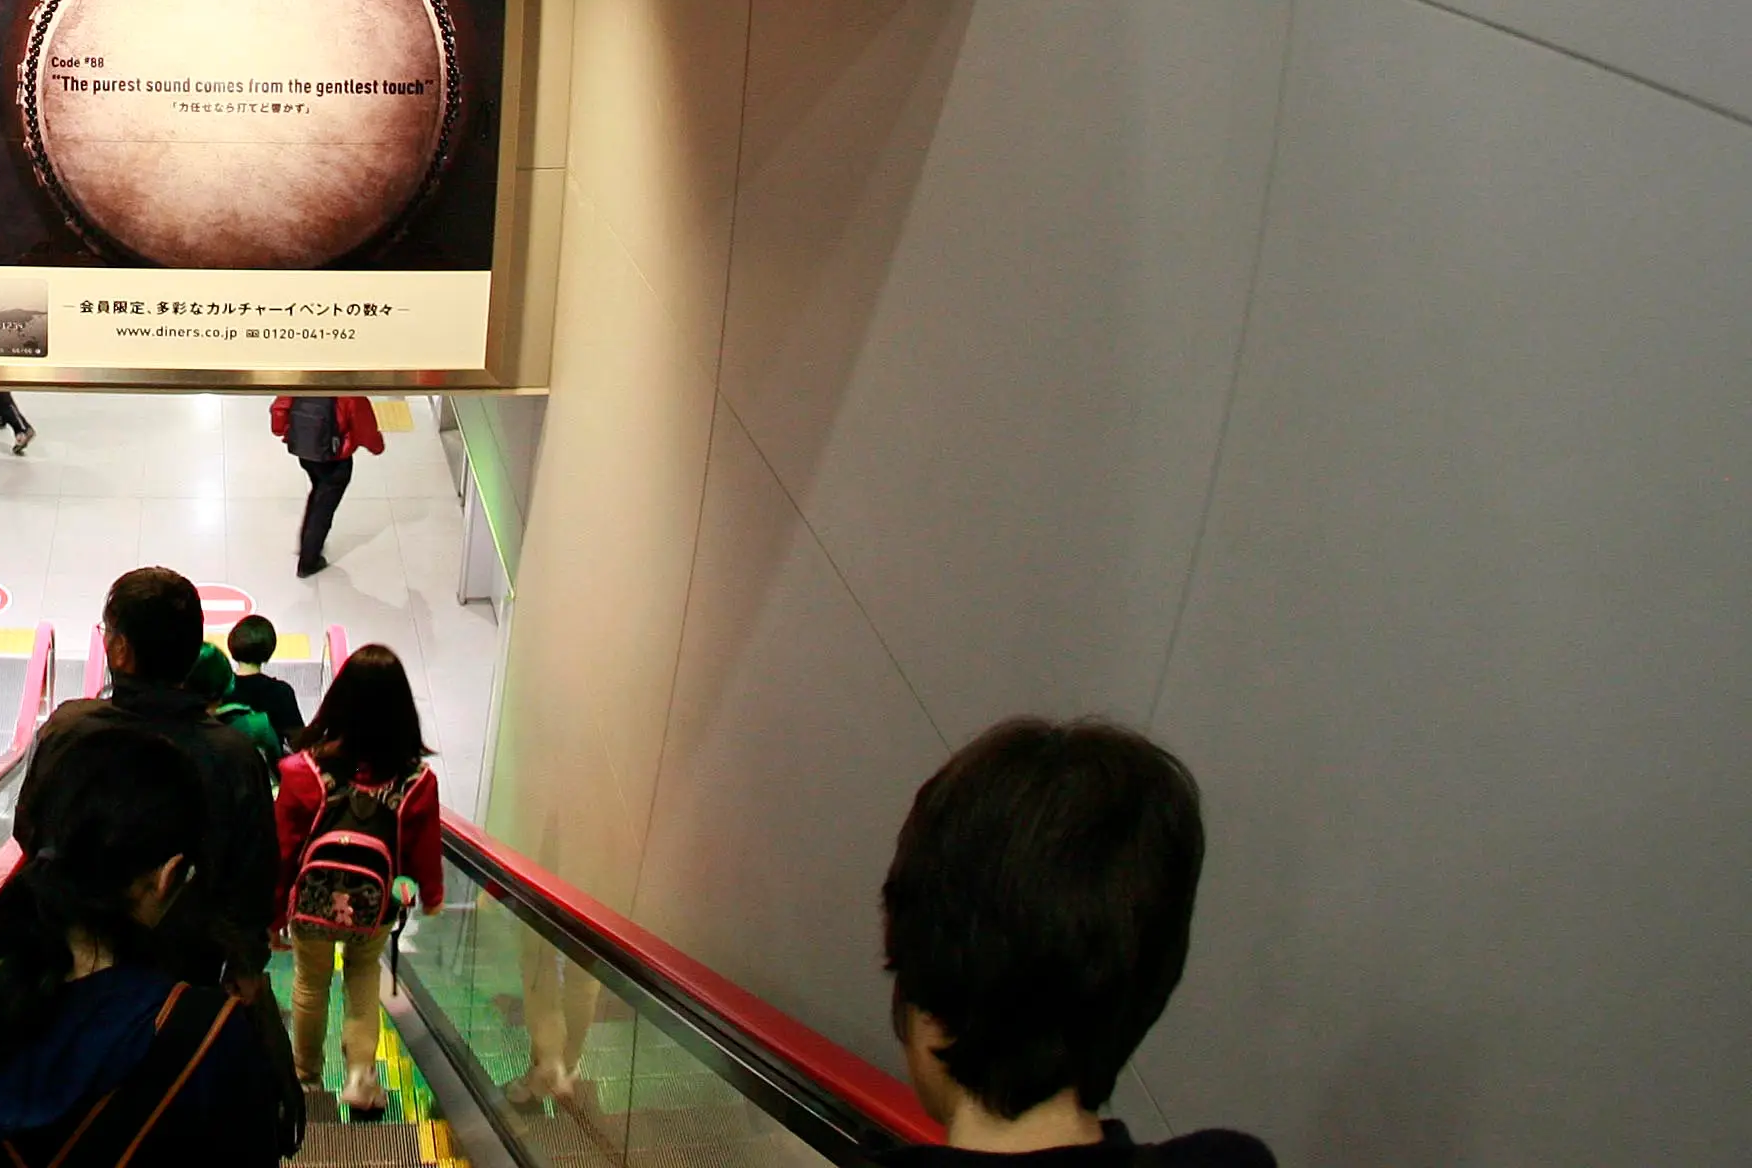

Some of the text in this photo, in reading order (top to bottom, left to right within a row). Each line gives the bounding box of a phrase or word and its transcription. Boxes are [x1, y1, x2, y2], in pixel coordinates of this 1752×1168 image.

[51, 56, 81, 68] Code
[93, 78, 141, 95] purest
[146, 78, 190, 93] sound
[195, 80, 244, 93] comes
[249, 78, 283, 93] from
[288, 78, 312, 94] the
[316, 78, 378, 96] gentlest
[116, 325, 357, 340] www.diners.co.jp 0120-041-962
